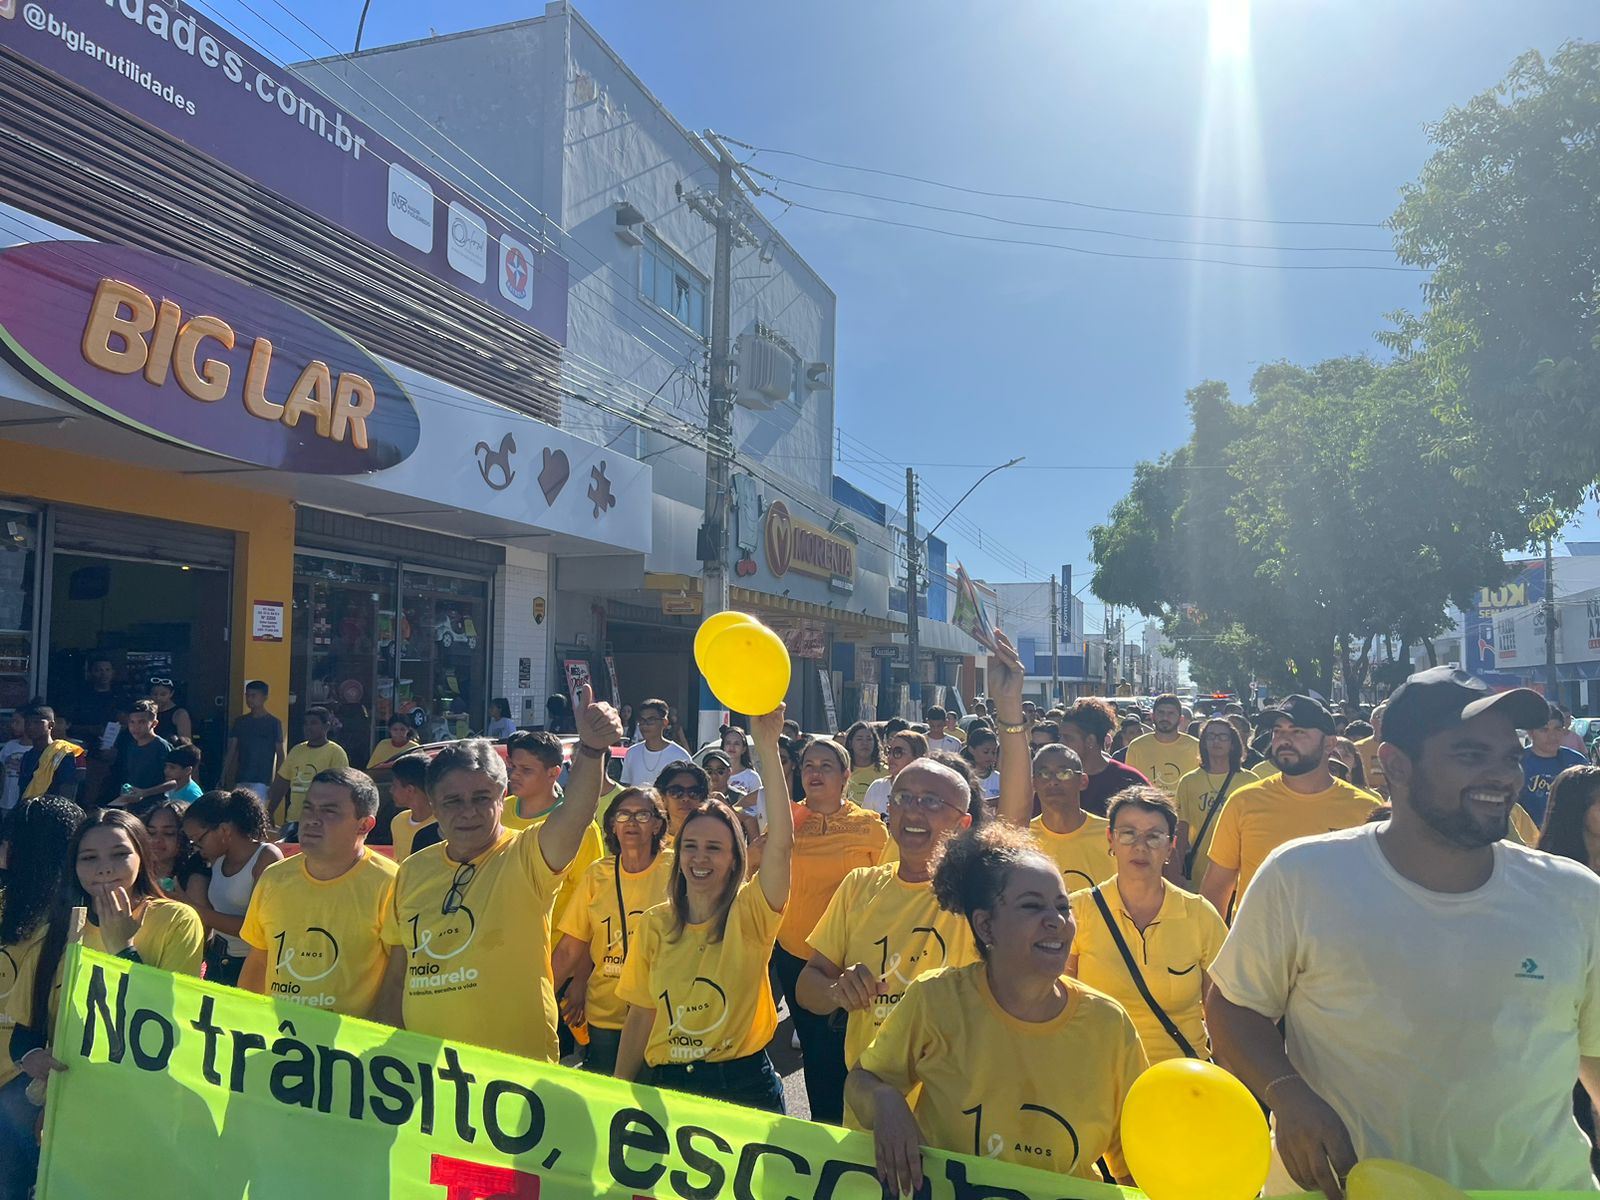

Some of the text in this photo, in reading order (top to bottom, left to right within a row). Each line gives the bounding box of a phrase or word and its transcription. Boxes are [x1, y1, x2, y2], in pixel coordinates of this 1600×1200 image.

[23, 3, 196, 115] @biglarutilidades
[105, 0, 367, 160] dades.com.br
[81, 277, 376, 450] BIG LAR
[271, 981, 301, 994] maio
[409, 962, 440, 976] maio
[686, 1002, 710, 1013] ANOS
[80, 965, 174, 1072] No
[190, 994, 561, 1170] trânsito,
[1015, 1143, 1053, 1156] ANOS
